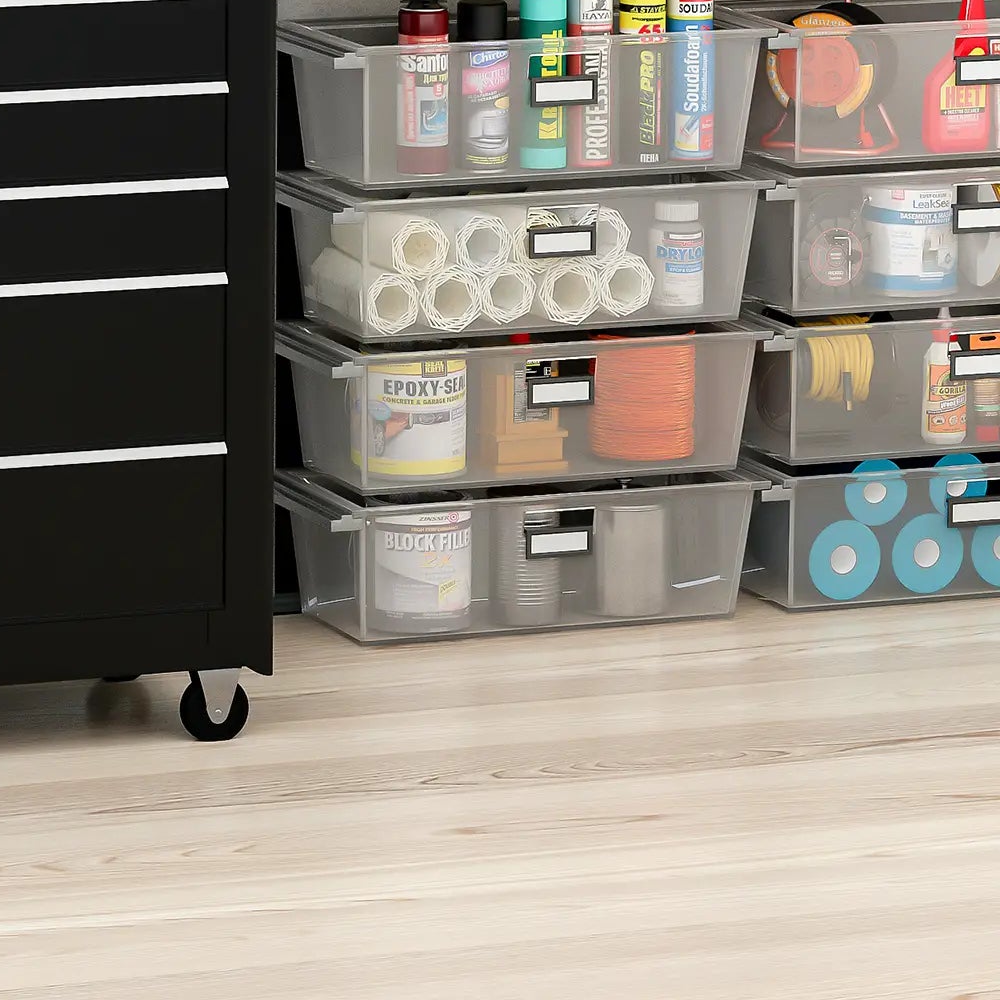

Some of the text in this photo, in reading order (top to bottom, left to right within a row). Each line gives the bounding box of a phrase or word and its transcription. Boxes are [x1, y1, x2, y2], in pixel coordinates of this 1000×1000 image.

[539, 30, 558, 139] KRTOOL
[683, 25, 699, 112] Soudafoam
[382, 396, 414, 405] CONCRETE
[384, 531, 437, 552] BLOCK
